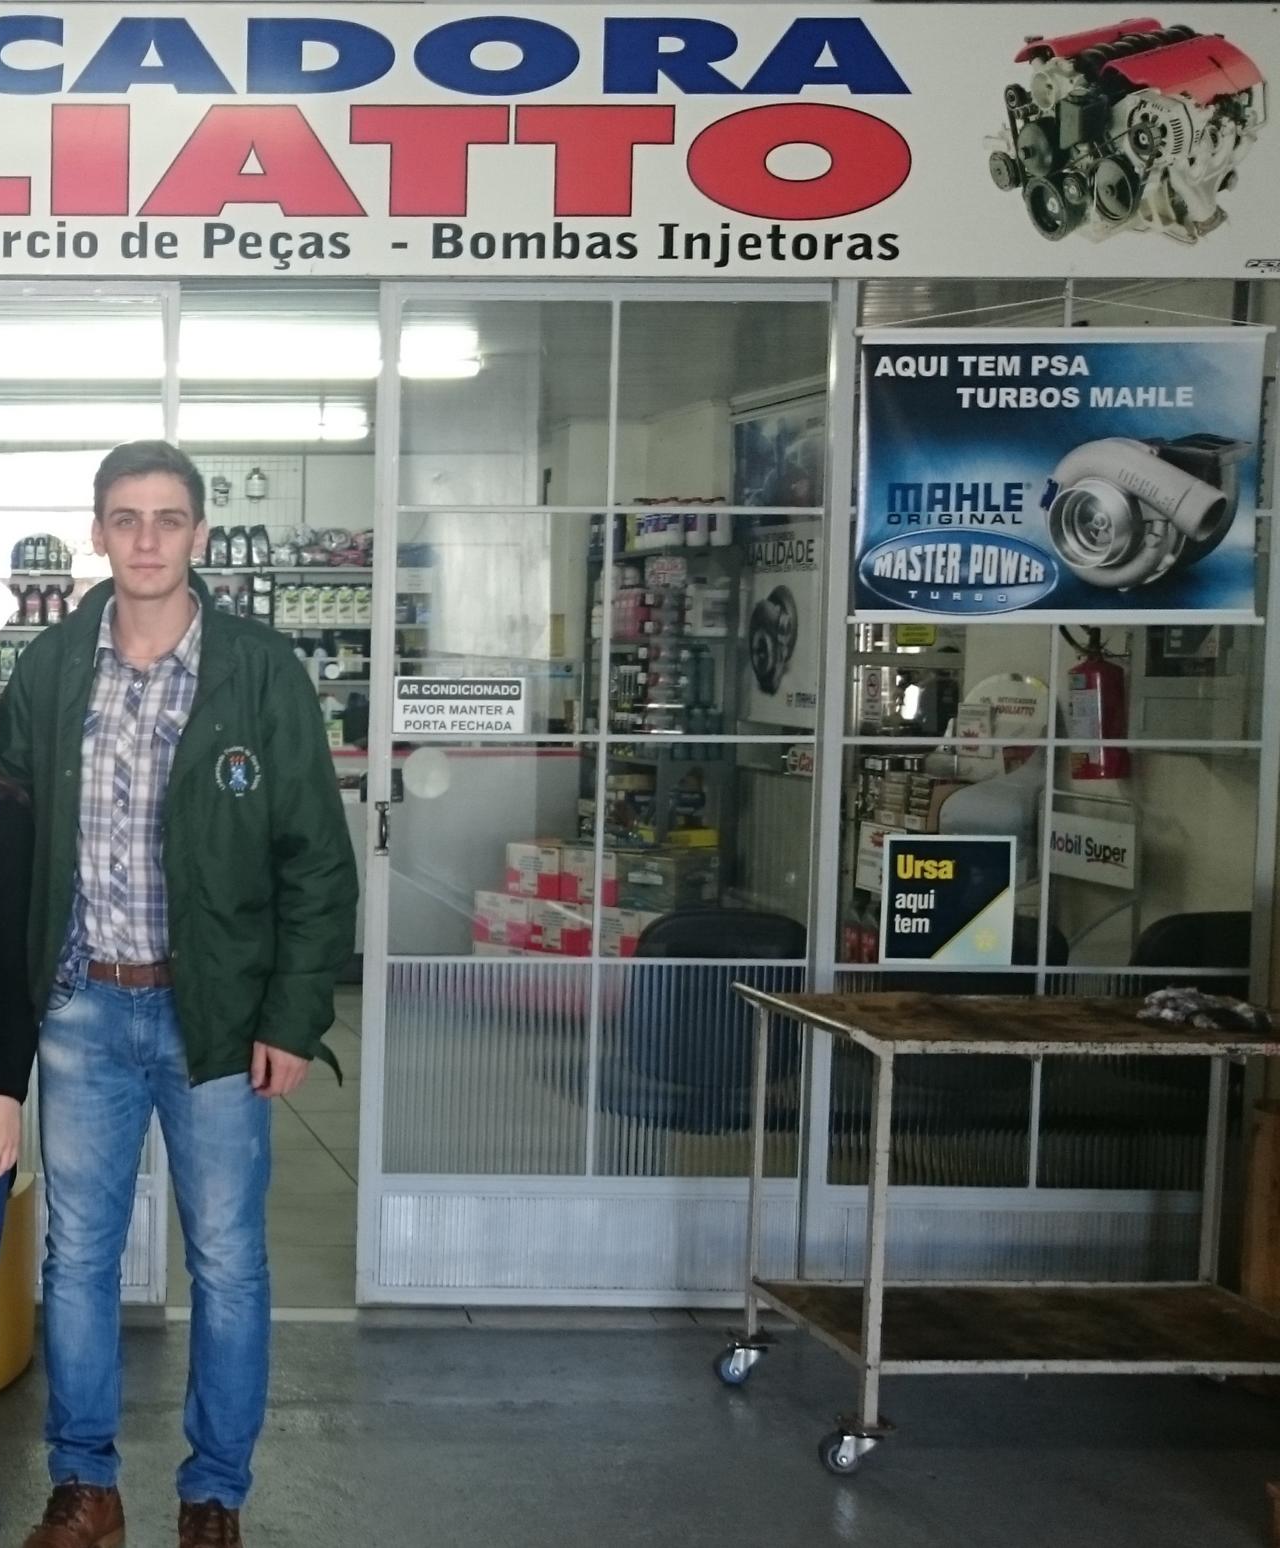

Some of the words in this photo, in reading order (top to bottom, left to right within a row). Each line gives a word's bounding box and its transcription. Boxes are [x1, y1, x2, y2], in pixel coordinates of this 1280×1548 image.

[121, 220, 178, 260] de
[203, 223, 351, 270] Peças
[431, 221, 639, 261] Bombas
[658, 222, 900, 267] Injetoras
[874, 355, 949, 378] AQUI
[957, 355, 1021, 377] TEM
[1030, 355, 1090, 377] PSA
[956, 386, 1081, 409] TURBOS
[1089, 386, 1194, 408] MAHLE
[887, 482, 1023, 513] MAHLE
[886, 513, 1023, 526] ORIGINAL
[740, 538, 816, 567] UALIDADE
[873, 543, 962, 585] MASTER
[967, 543, 1045, 585] POWER
[908, 590, 1008, 603] TURBO
[400, 684, 419, 695] AR
[421, 684, 520, 696] CONDICIONADO
[402, 704, 445, 715] FAVOR
[448, 705, 503, 716] MANTER
[506, 705, 515, 716] A
[404, 720, 447, 731] PORTA
[450, 720, 512, 731] FECHADA
[1085, 836, 1127, 865] Super
[896, 854, 955, 880] Ursa
[895, 889, 936, 914] aqui
[894, 913, 931, 934] tem
